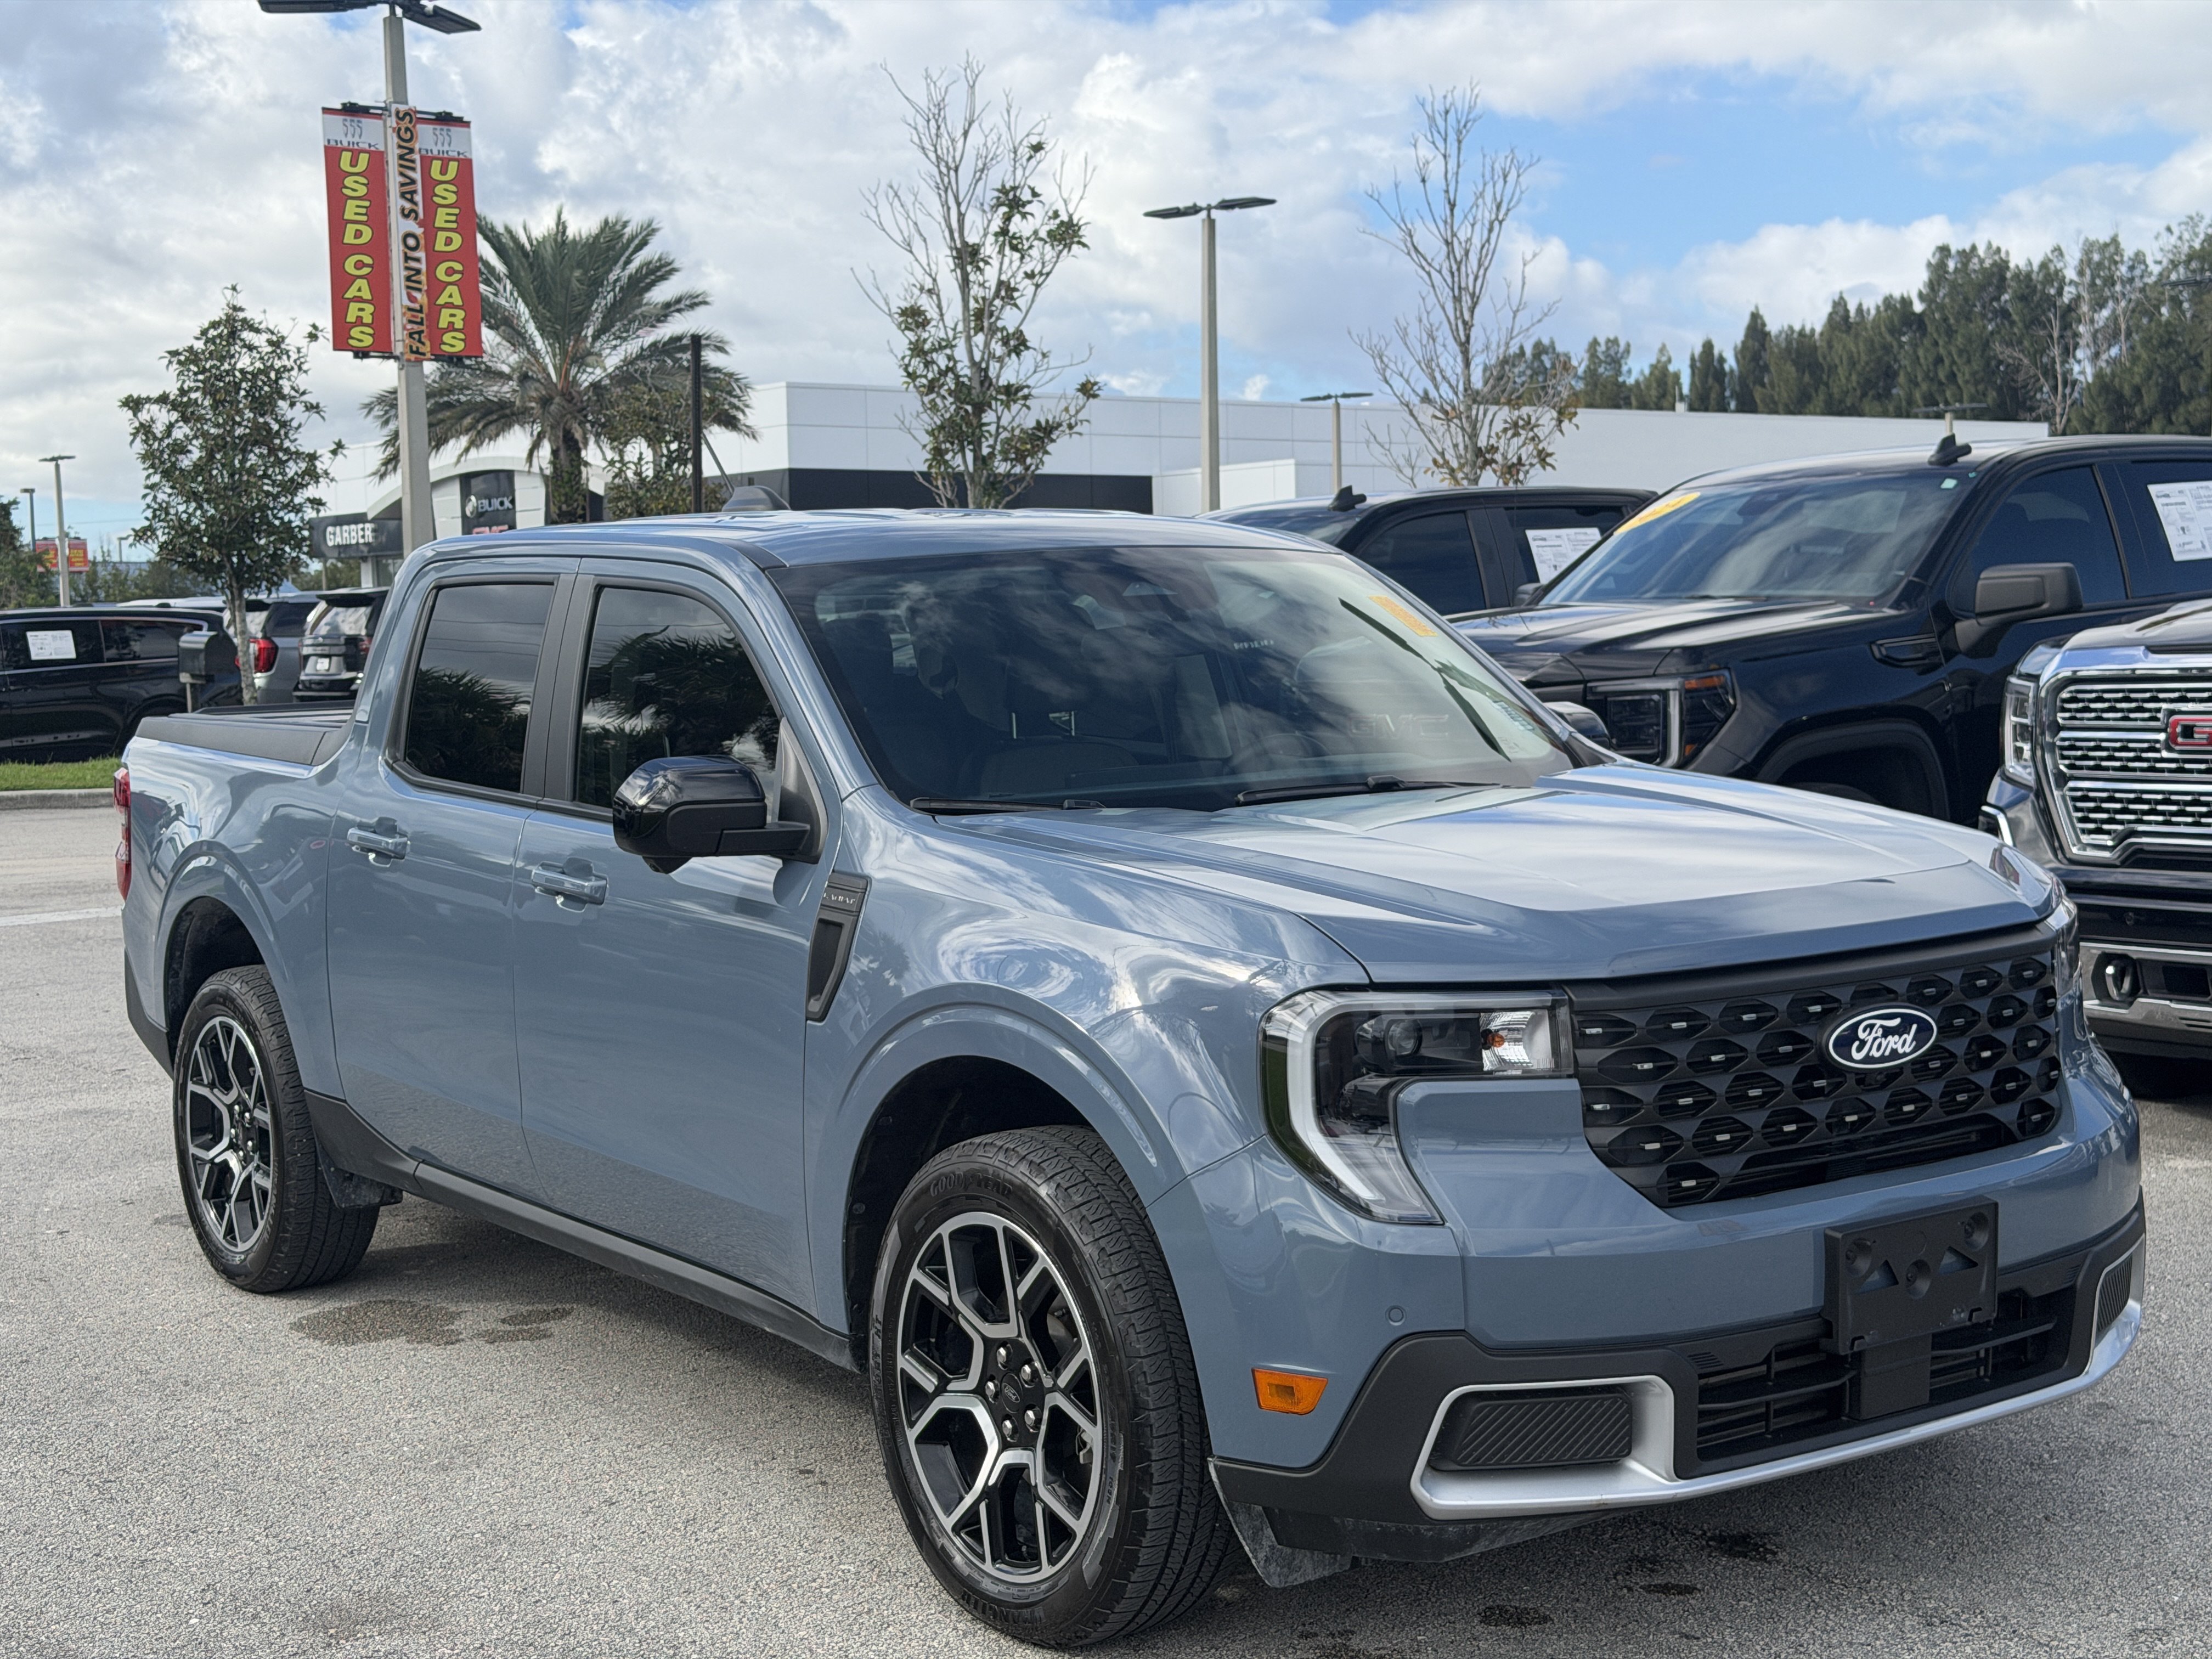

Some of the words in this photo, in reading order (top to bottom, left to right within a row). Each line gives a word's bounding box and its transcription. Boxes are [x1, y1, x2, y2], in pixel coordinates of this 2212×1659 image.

[338, 150, 374, 246] USED
[396, 109, 419, 222] SAVINGS
[429, 159, 463, 252] USED
[342, 253, 376, 348] CARS
[403, 232, 425, 293] INTO
[408, 303, 427, 358] FALL
[435, 260, 466, 353] CARS
[326, 523, 374, 546] GARBER
[478, 496, 513, 512] BUICK
[1851, 1017, 1918, 1060] Ford
